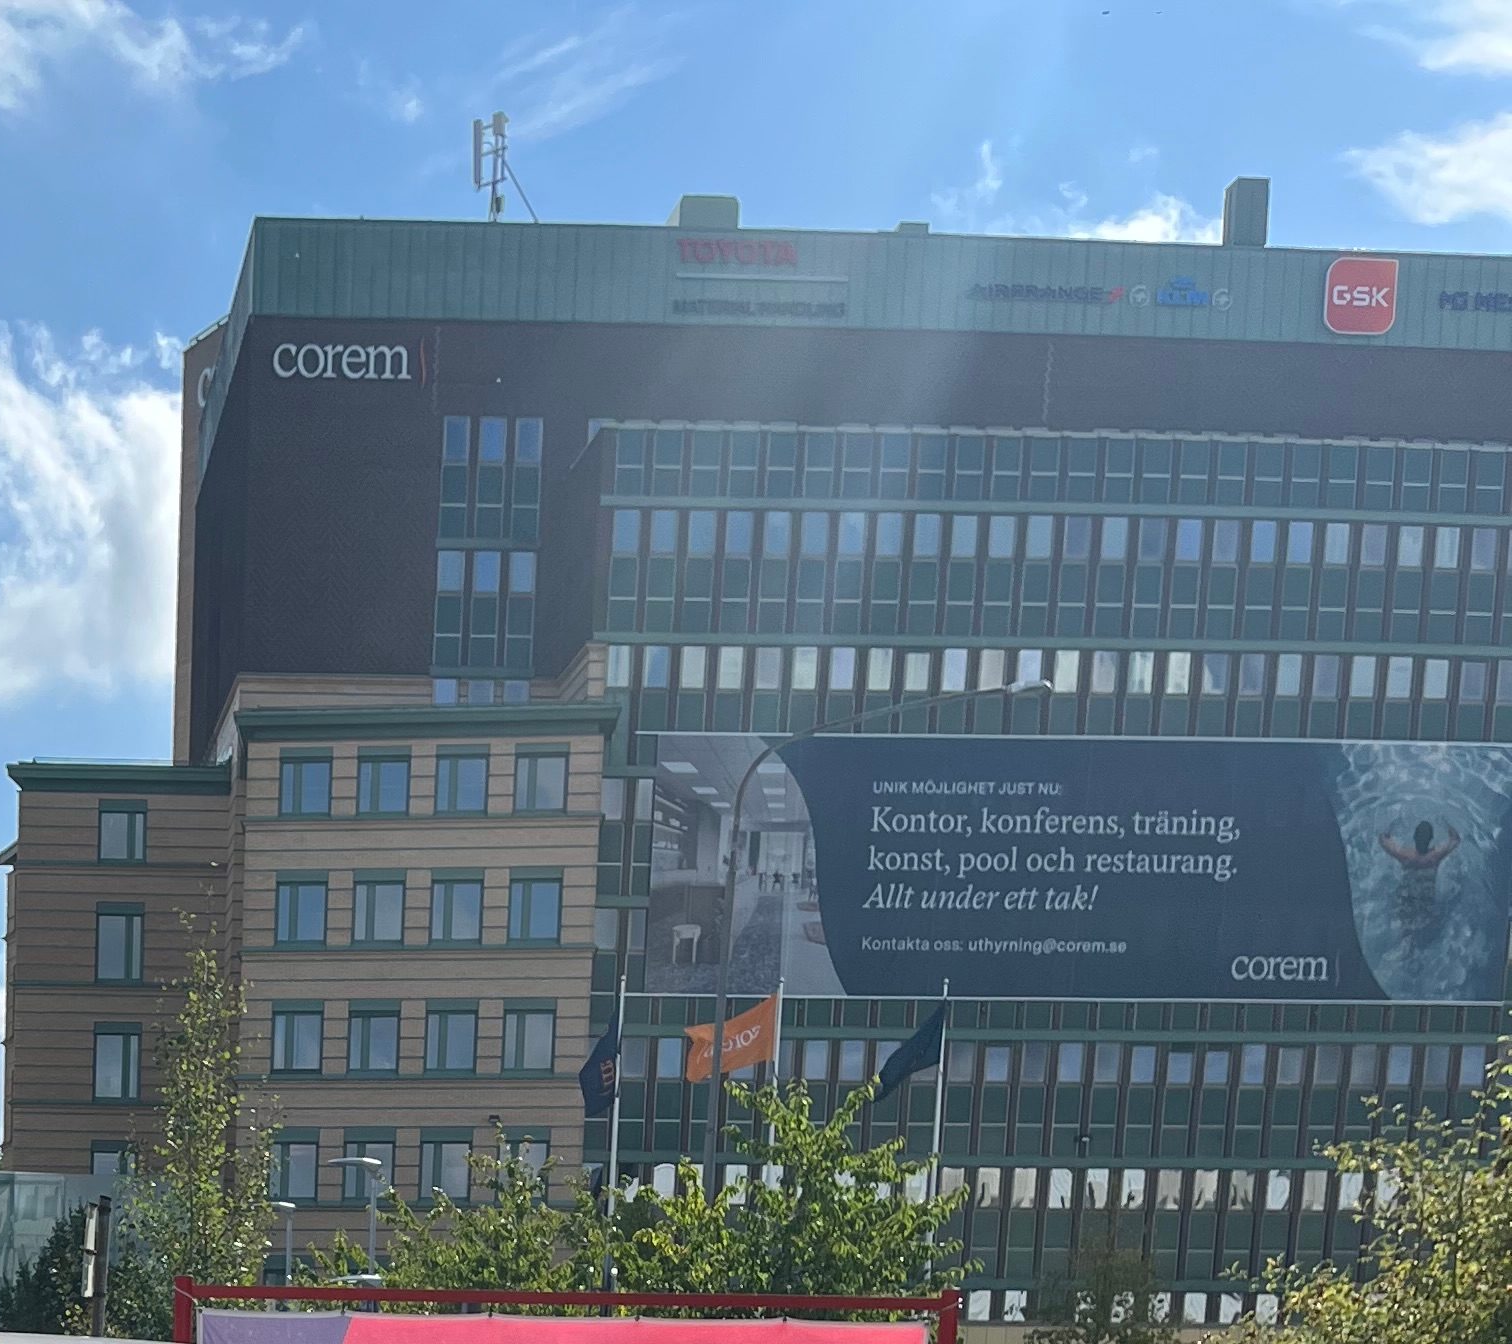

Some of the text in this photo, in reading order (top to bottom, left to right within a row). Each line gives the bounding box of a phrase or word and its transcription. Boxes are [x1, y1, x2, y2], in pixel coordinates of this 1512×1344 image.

[677, 238, 797, 266] TOYOTA
[1332, 285, 1390, 308] GSK
[272, 342, 412, 380] corem
[873, 780, 908, 795] UNIK
[911, 778, 994, 796] MÖJLIGHET
[998, 781, 1034, 796] JUST
[870, 806, 1241, 844] Kontor, konferens, träning,
[867, 845, 1238, 882] konst, pool och restaurang.
[862, 883, 1099, 911] Allt under ett tak!
[861, 936, 1128, 956] Kontakta oss: uthyrning@corem.se
[1230, 954, 1329, 982] corem
